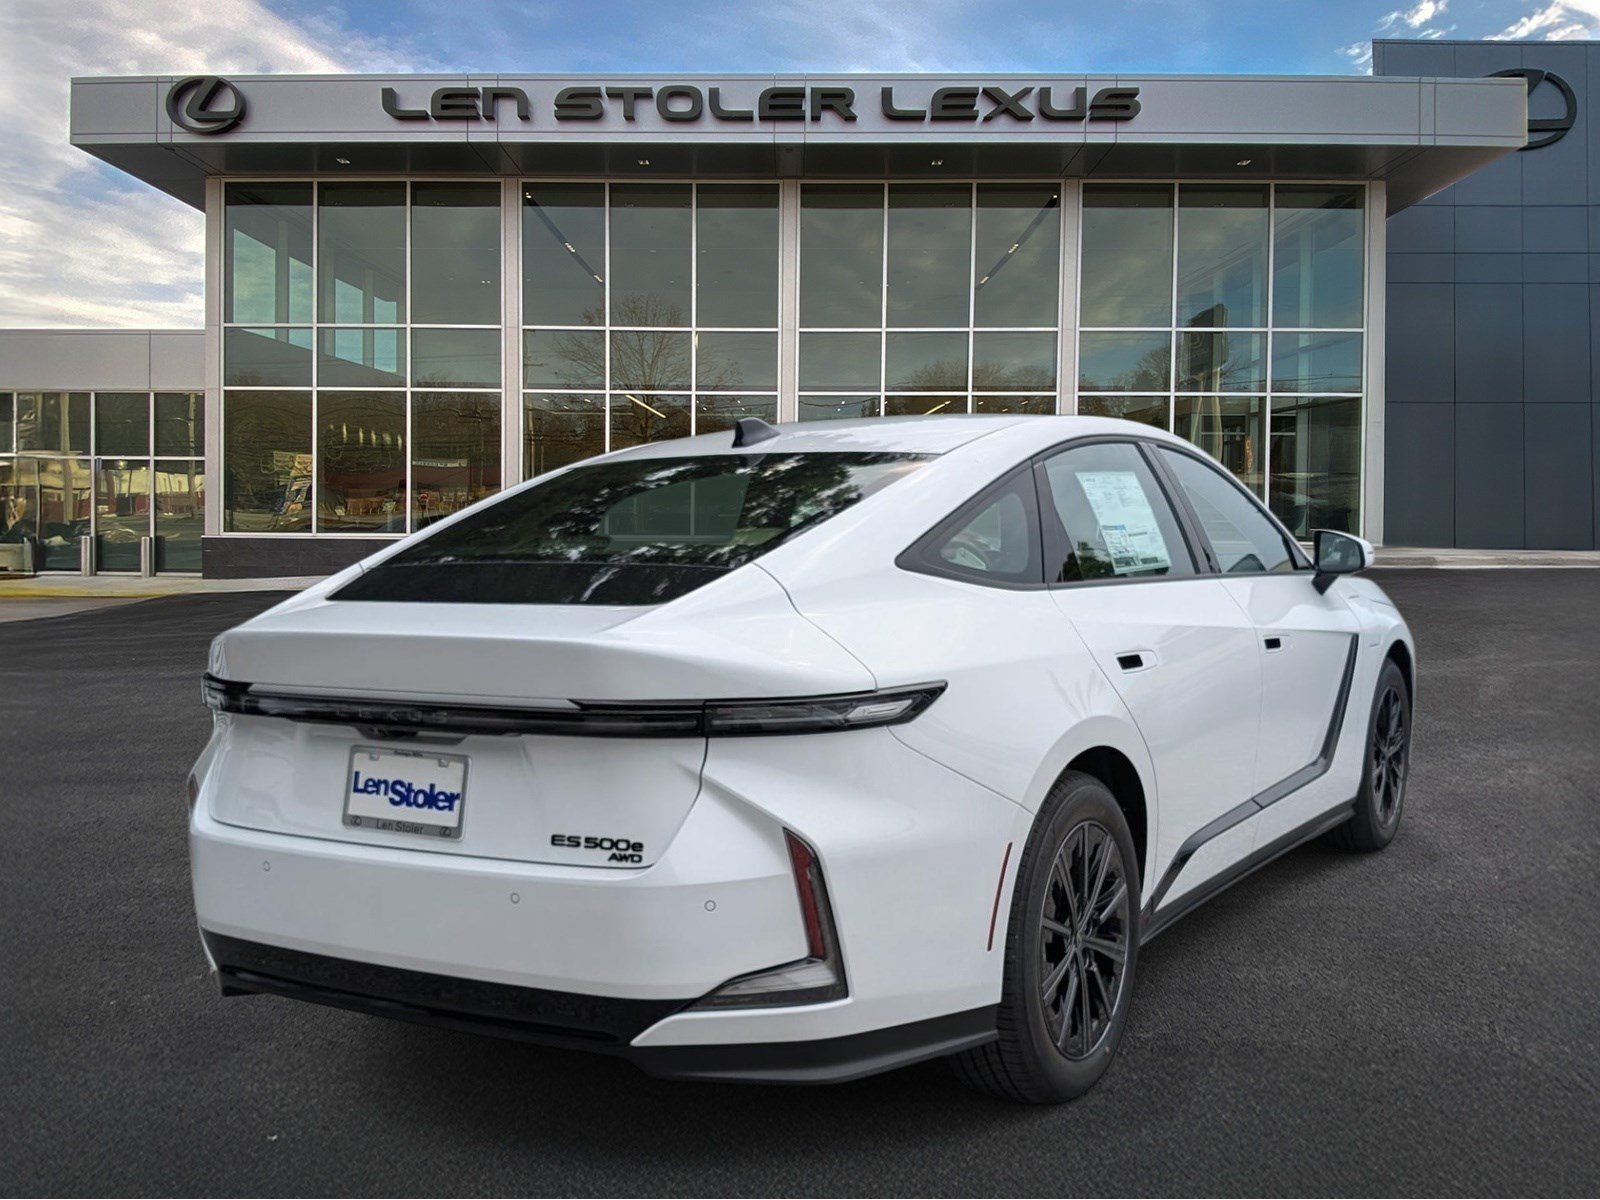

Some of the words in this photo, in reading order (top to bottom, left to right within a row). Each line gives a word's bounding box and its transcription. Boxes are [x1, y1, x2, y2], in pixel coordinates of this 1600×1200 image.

[381, 87, 531, 121] LEN
[554, 85, 858, 122] STOLER
[881, 87, 1142, 121] LEXUS
[376, 819, 394, 831] Len
[395, 821, 424, 834] Stoler
[551, 834, 581, 848] ES
[583, 836, 644, 852] 500e
[608, 852, 643, 863] AWD
